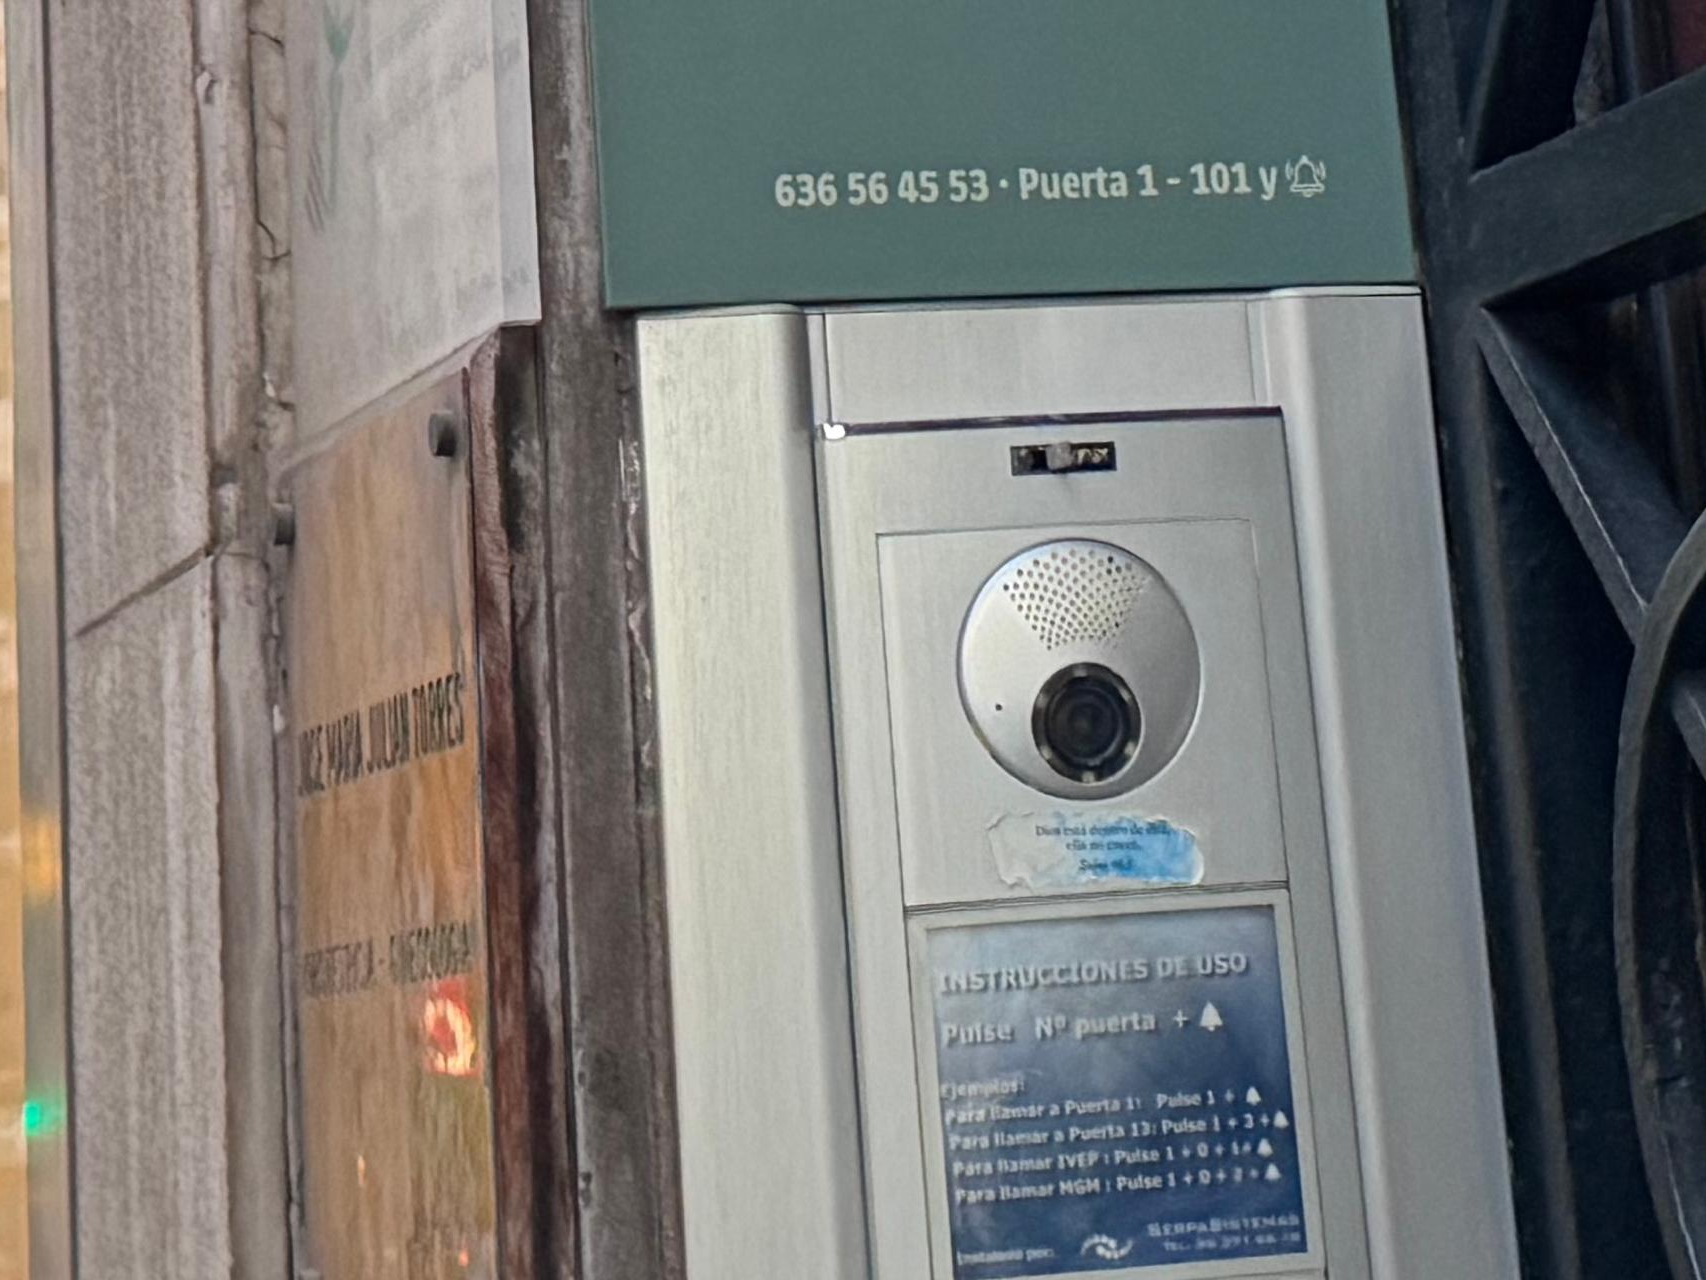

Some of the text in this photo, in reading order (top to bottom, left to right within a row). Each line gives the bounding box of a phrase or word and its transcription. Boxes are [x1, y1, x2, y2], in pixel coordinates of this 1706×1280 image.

[774, 172, 838, 207] 636
[847, 172, 888, 206] 56
[898, 171, 939, 205] 45
[948, 169, 990, 203] 53
[1018, 167, 1129, 201] Puerta
[1137, 165, 1159, 197] 1
[1190, 163, 1251, 196] 101
[1258, 170, 1278, 201] y
[938, 951, 1249, 995] INSTRUCCIONES DE USO
[942, 1022, 1014, 1048] Pulse
[1075, 1011, 1157, 1041] puerta
[945, 1108, 986, 1127] Para
[990, 1102, 1045, 1121] llamar
[1049, 1103, 1061, 1117] a
[1064, 1098, 1122, 1116] Puerta
[1156, 1091, 1203, 1109] Pulse
[948, 1133, 991, 1152] Para
[994, 1130, 1050, 1148] llamar
[1054, 1130, 1065, 1143] a
[1068, 1124, 1126, 1142] Puerta
[1161, 1117, 1208, 1135] Pulse
[952, 1160, 994, 1178] Para
[996, 1156, 1054, 1174] llamar
[1057, 1150, 1100, 1170] IVEP
[1114, 1147, 1161, 1166] Pulse
[955, 1187, 996, 1206] Para
[998, 1183, 1056, 1201] llamar
[1058, 1177, 1101, 1196] MGM
[1116, 1174, 1163, 1192] Pulse
